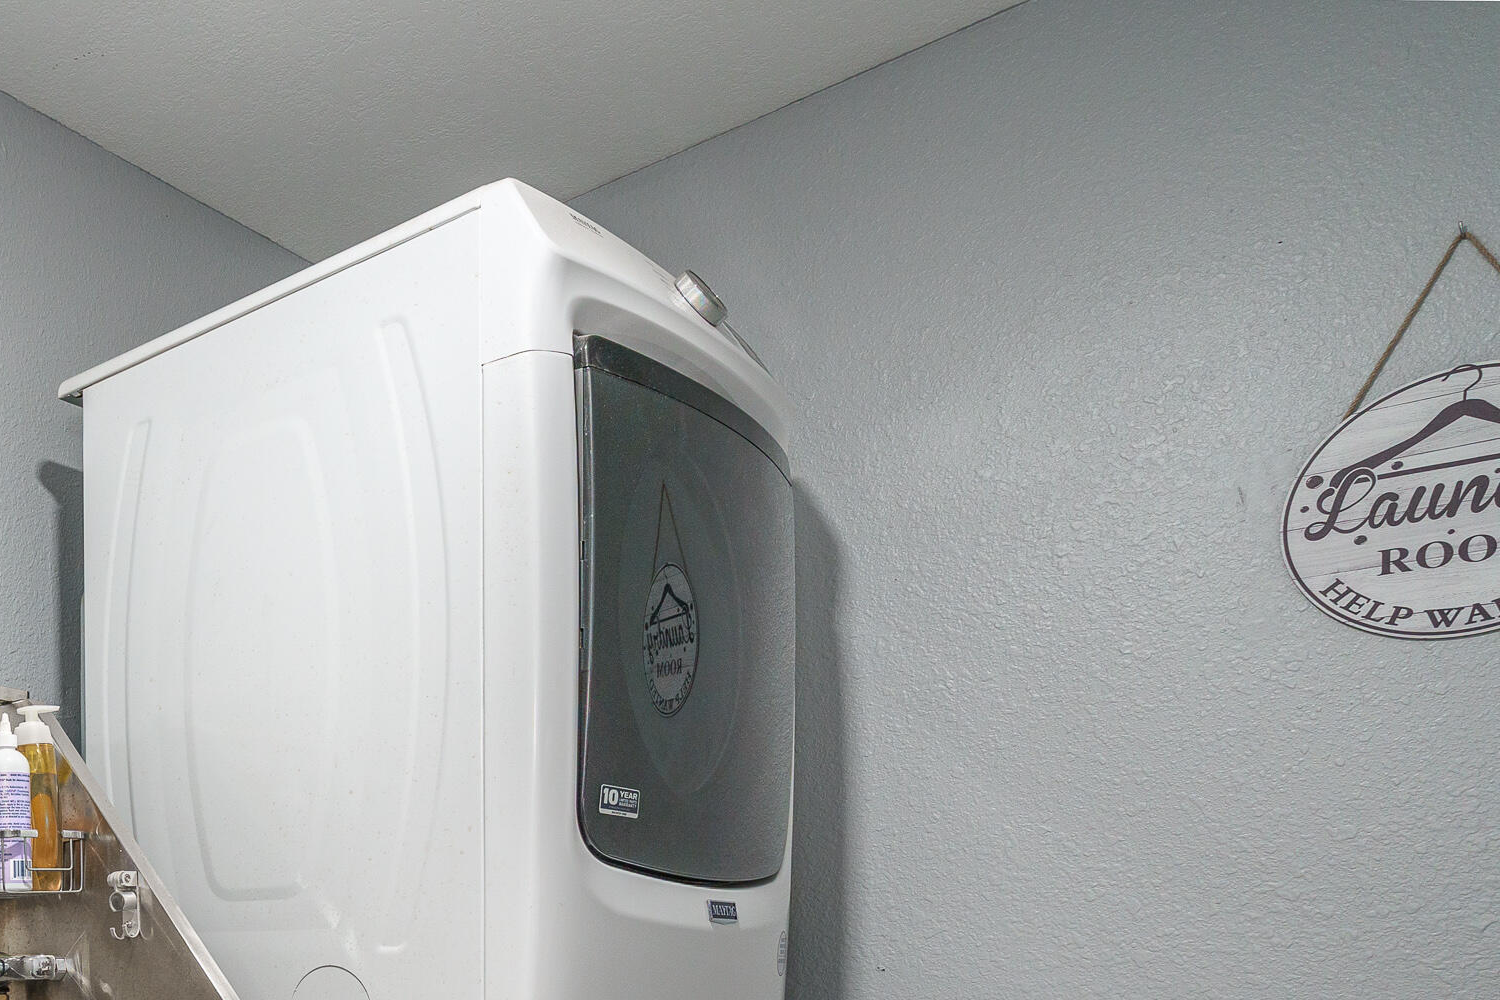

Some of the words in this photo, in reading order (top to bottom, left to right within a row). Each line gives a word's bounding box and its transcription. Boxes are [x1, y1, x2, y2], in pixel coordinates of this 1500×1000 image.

[1304, 467, 1500, 541] Laun
[1318, 578, 1414, 626] HELP
[1424, 599, 1500, 629] WA
[603, 787, 619, 806] 10
[620, 790, 638, 801] YEAR
[712, 904, 736, 917] MAYTAG
